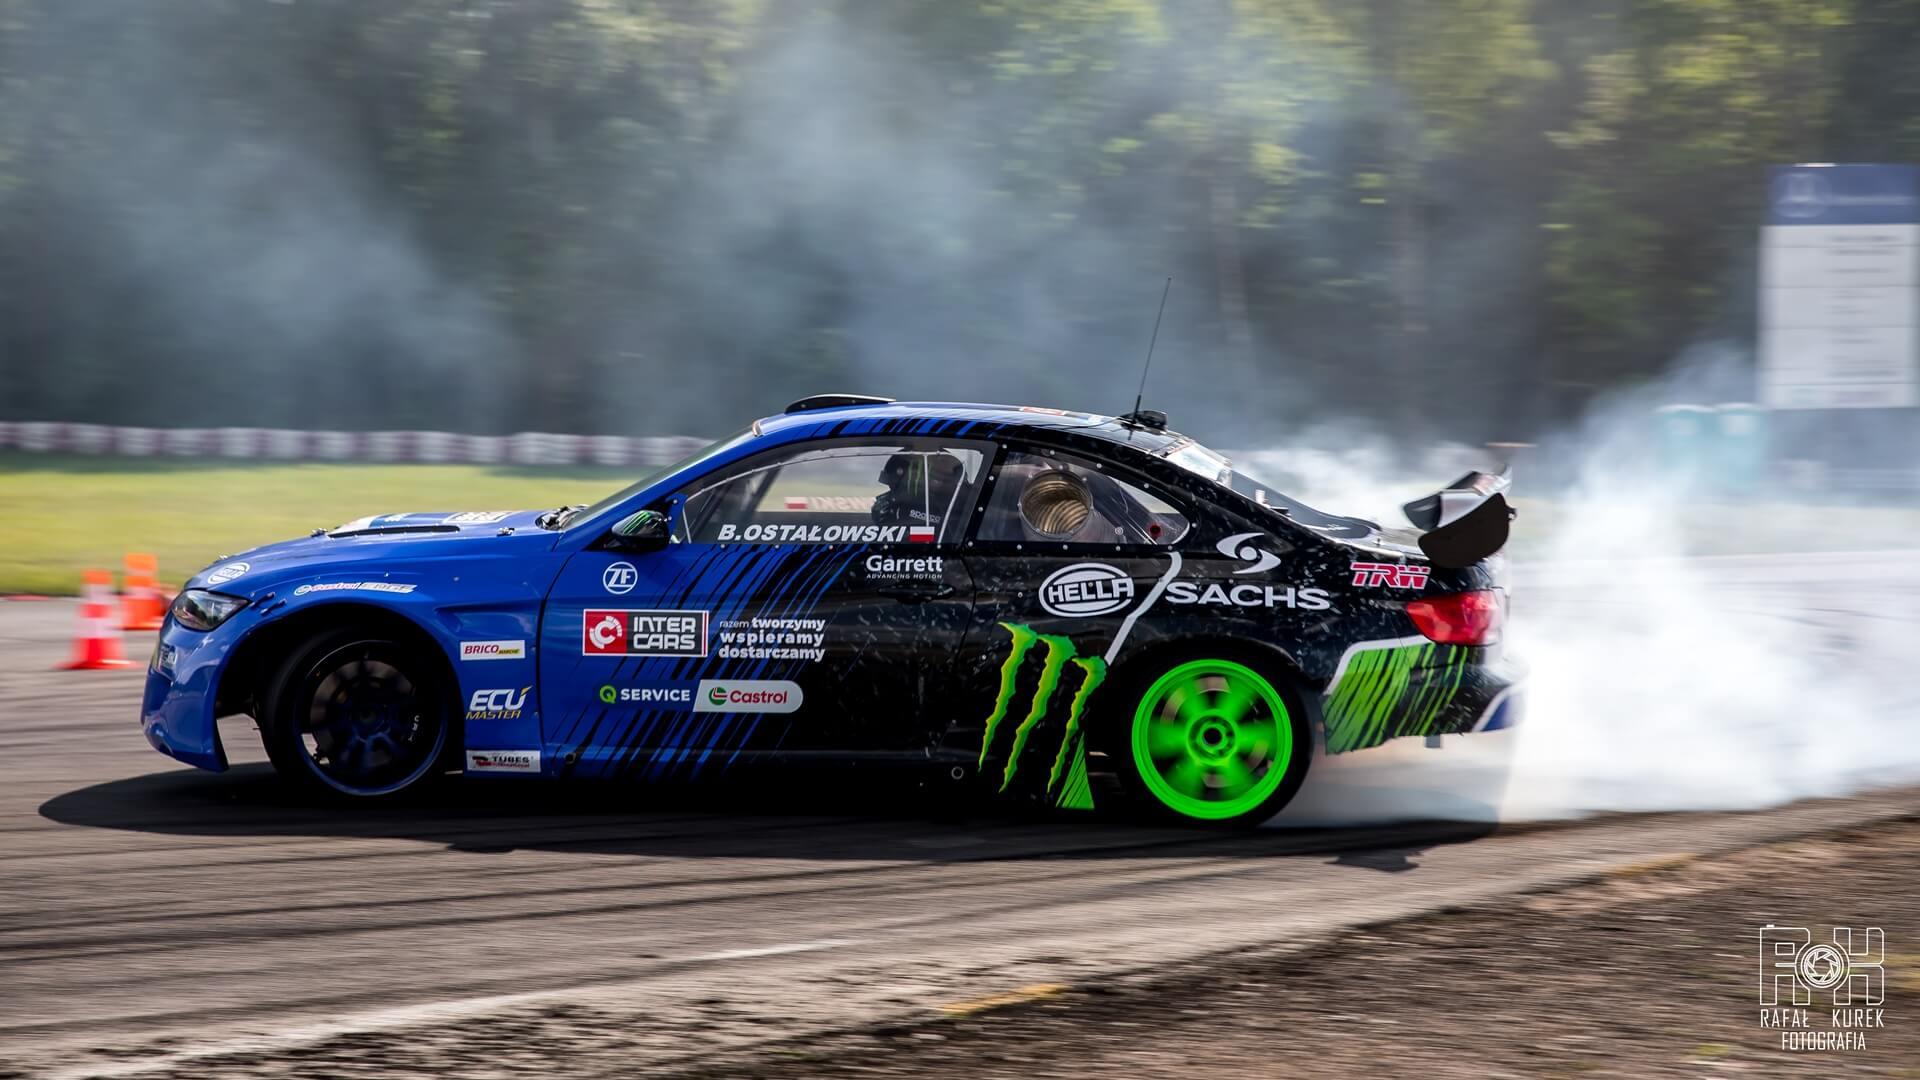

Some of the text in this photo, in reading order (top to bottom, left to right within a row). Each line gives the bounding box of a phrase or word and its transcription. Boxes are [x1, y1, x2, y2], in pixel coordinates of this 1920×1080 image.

[909, 509, 942, 523] spaco
[717, 524, 907, 543] B.OSTAŁOWSKI
[866, 554, 944, 572] Garrett
[607, 568, 633, 588] ZF
[1350, 562, 1431, 590] TRW
[1048, 578, 1135, 602] HELLA
[1165, 581, 1331, 611] SACHS
[633, 616, 697, 633] INTER
[719, 617, 825, 631] razem tworzymy
[633, 633, 696, 650] CARS
[720, 629, 824, 647] wspieramy
[464, 644, 499, 655] BRICO
[718, 644, 825, 662] dostarczamy
[469, 688, 530, 712] ECU
[620, 688, 690, 702] SERVICE
[730, 690, 787, 704] Castrol
[466, 711, 521, 720] MASTER
